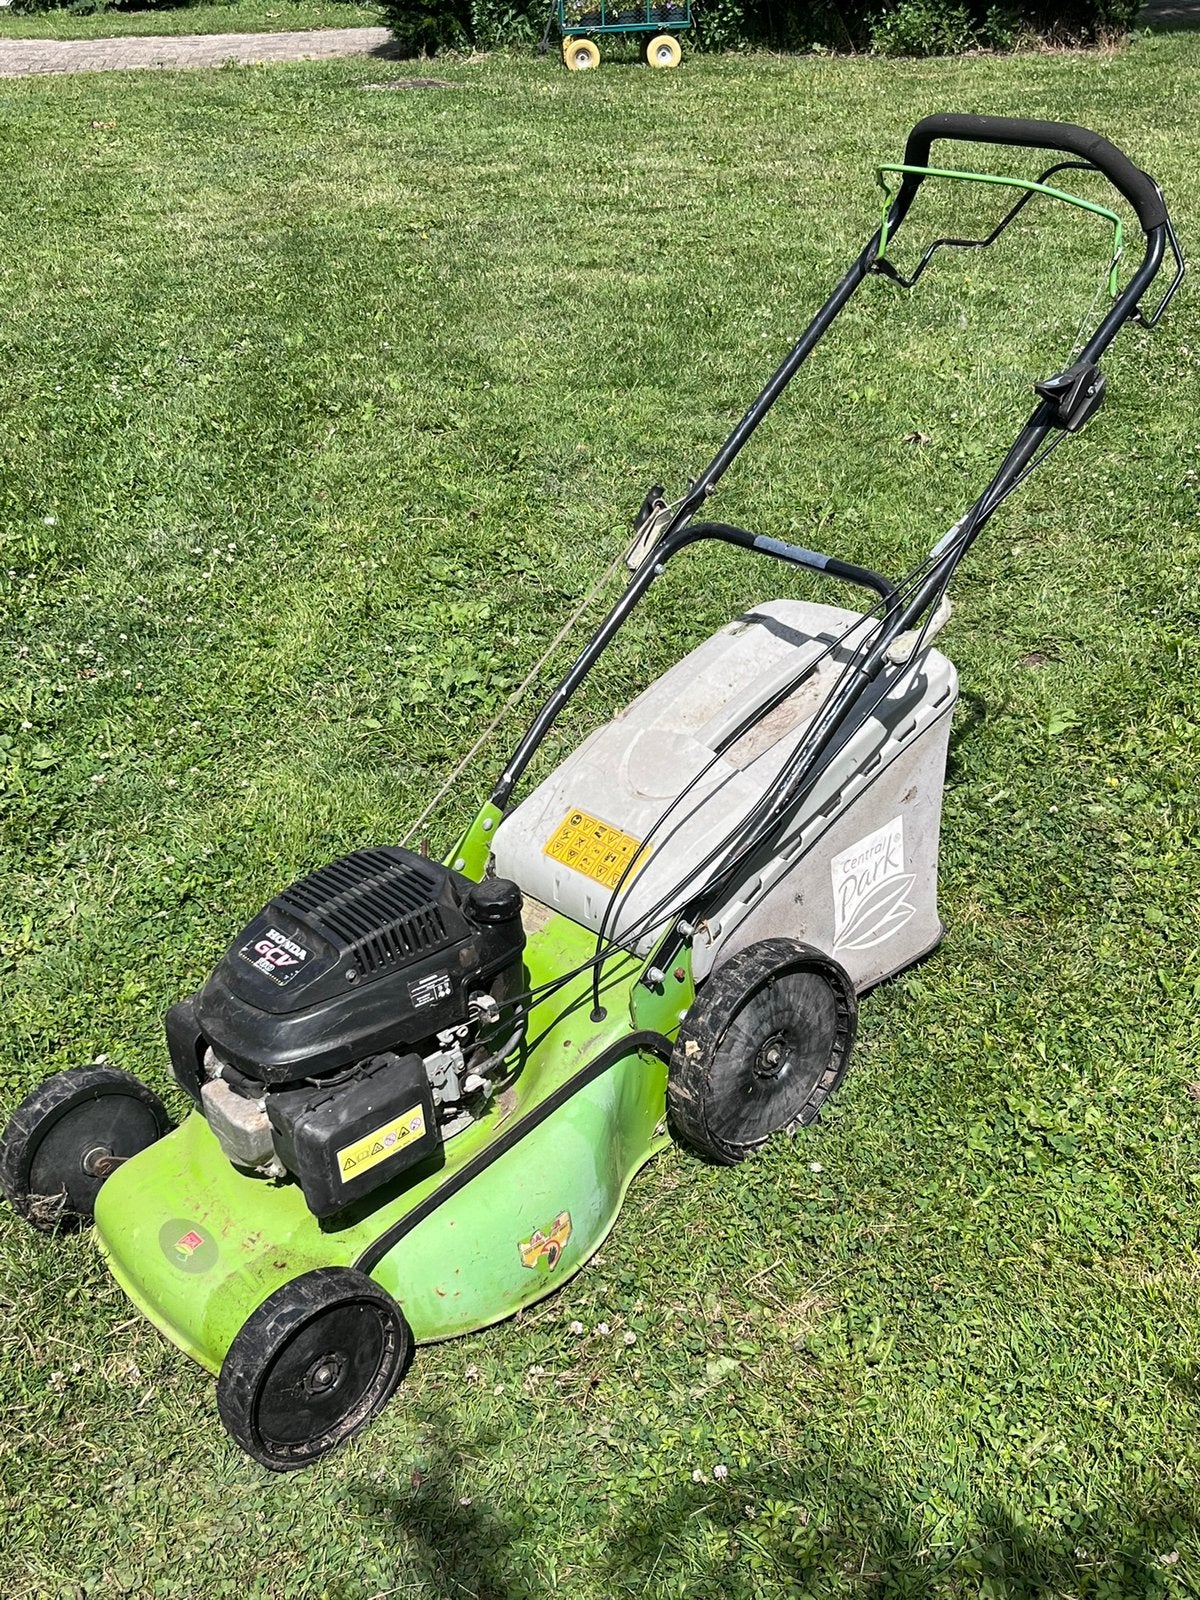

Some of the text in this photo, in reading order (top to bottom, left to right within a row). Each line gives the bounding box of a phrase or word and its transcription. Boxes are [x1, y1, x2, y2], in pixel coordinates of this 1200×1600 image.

[843, 836, 887, 873] Central
[838, 833, 899, 924] Park
[254, 940, 299, 966] GCV
[265, 928, 307, 960] HONDA
